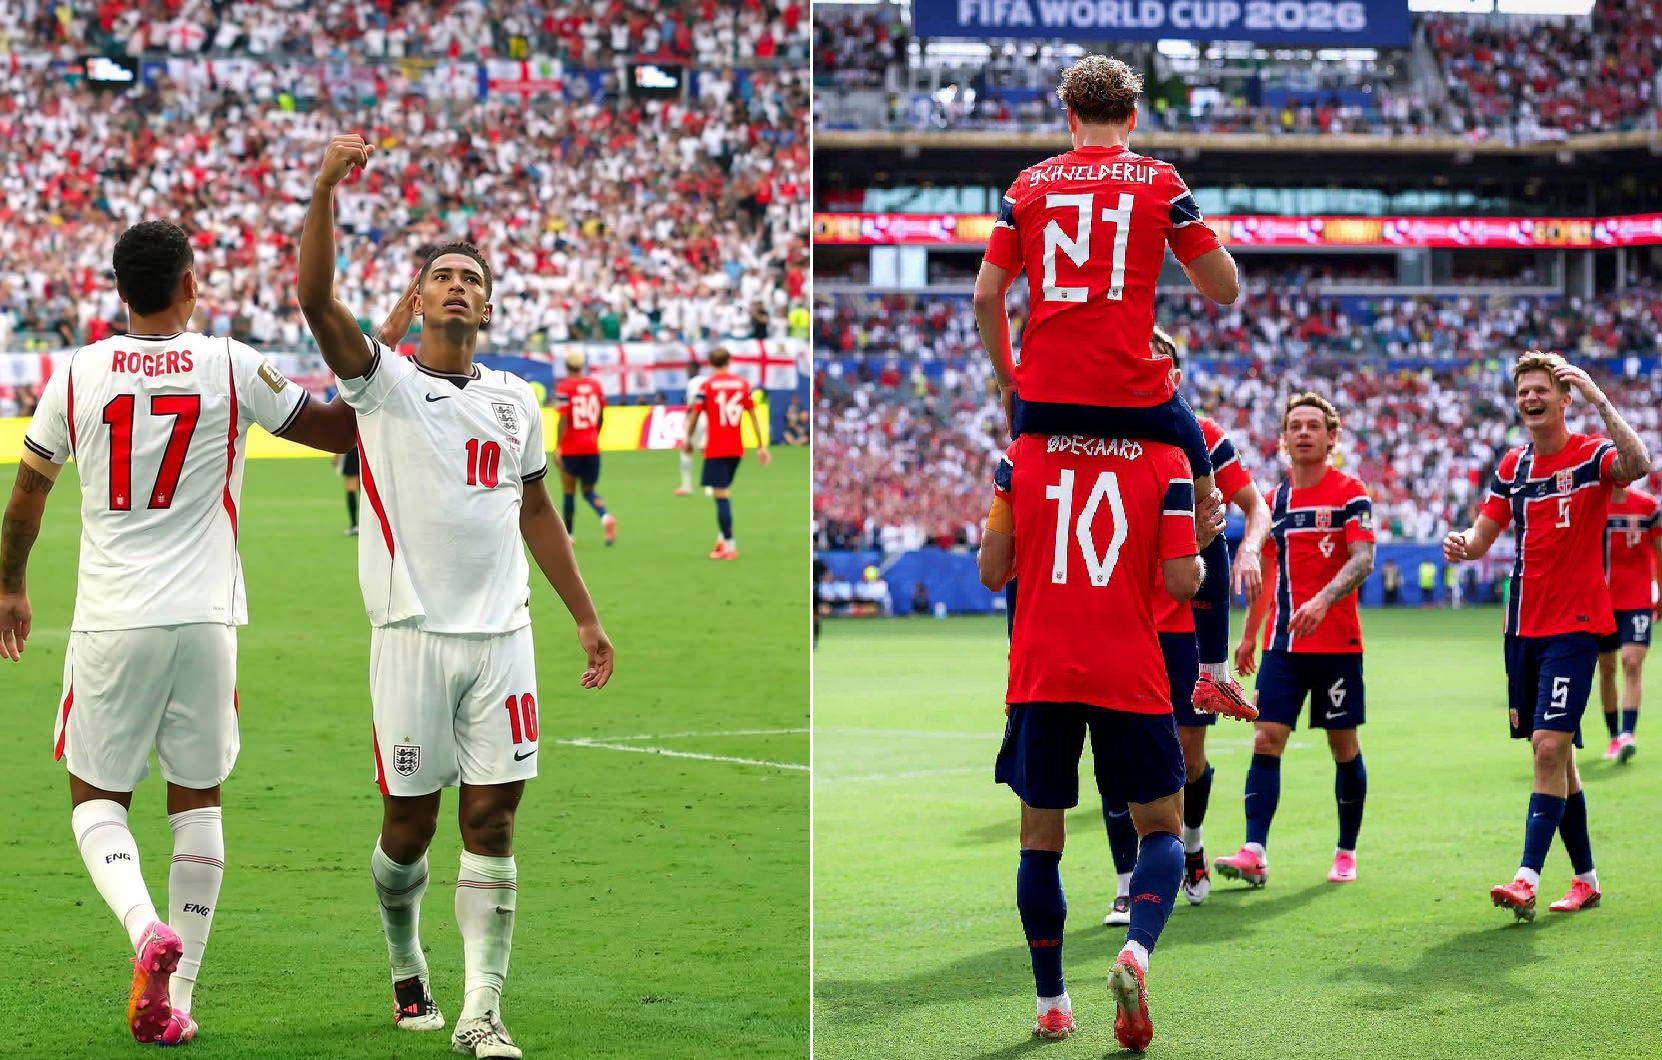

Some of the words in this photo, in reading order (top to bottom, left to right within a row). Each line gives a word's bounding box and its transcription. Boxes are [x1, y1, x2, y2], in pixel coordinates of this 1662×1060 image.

[957, 0, 1035, 26] FIFA
[1038, 0, 1164, 28] WORLD
[1169, 0, 1240, 29] CUP
[1243, 1, 1366, 31] 2026
[1029, 162, 1158, 188] SCHJELDERUP
[1043, 193, 1135, 302] 21
[112, 349, 193, 378] ROGERS
[714, 390, 745, 427] 16
[102, 393, 201, 511] 17
[1046, 434, 1143, 460] ØDEGAARD
[465, 438, 501, 489] 10
[1045, 468, 1129, 587] 10
[1555, 497, 1573, 529] 5
[1318, 533, 1336, 560] 6
[1326, 677, 1347, 708] 6
[1550, 676, 1571, 710] 5
[505, 692, 539, 745] 10
[105, 852, 131, 864] ENG
[183, 903, 210, 917] ENG
